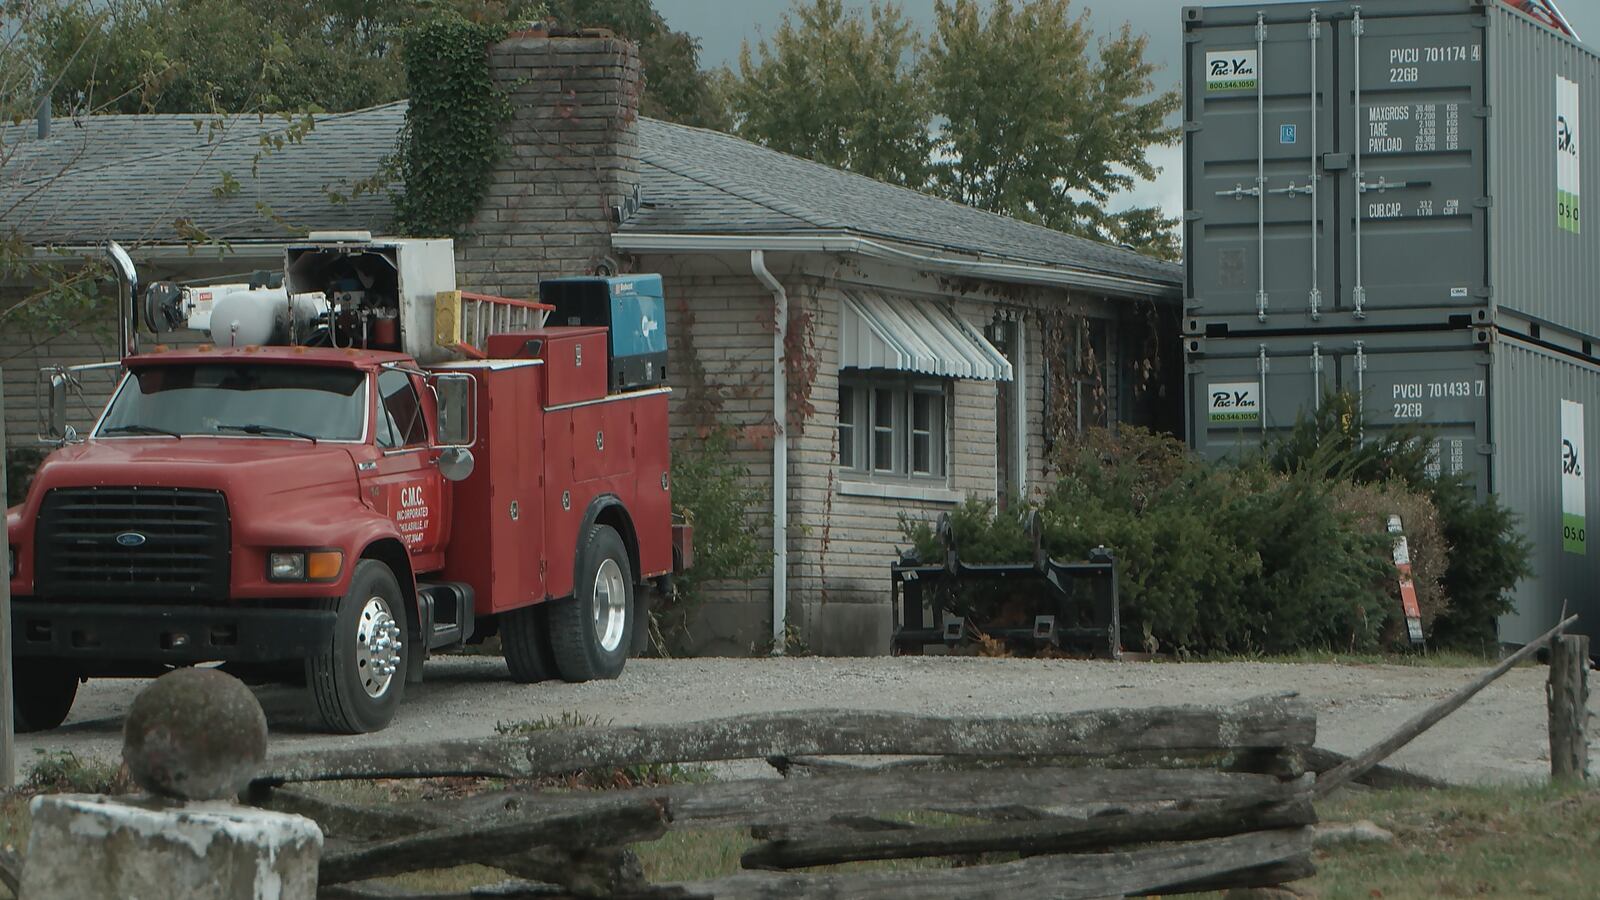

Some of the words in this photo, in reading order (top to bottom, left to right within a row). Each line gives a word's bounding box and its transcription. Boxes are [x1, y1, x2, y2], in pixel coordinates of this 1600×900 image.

[1390, 48, 1419, 64] PVCU
[1424, 46, 1466, 62] 701174
[1471, 45, 1480, 61] 4
[1390, 67, 1418, 83] 22GB
[1209, 81, 1254, 89] 800.546.1050
[1369, 106, 1409, 121] MAXGROSS
[1446, 103, 1458, 111] KGS
[1369, 122, 1388, 137] TARE
[1446, 119, 1458, 127] KGS
[1446, 127, 1458, 135] LBS
[1369, 137, 1402, 152] PAYLOAD
[1446, 142, 1458, 150] LBS
[1369, 202, 1403, 218] CUB.CAP.
[1393, 384, 1422, 399] PVCU
[1427, 382, 1470, 398] 701433
[1475, 380, 1485, 397] 7
[1212, 413, 1257, 421] 800.546.1050
[1394, 403, 1422, 418] 22GB
[401, 486, 424, 508] C.M.C.
